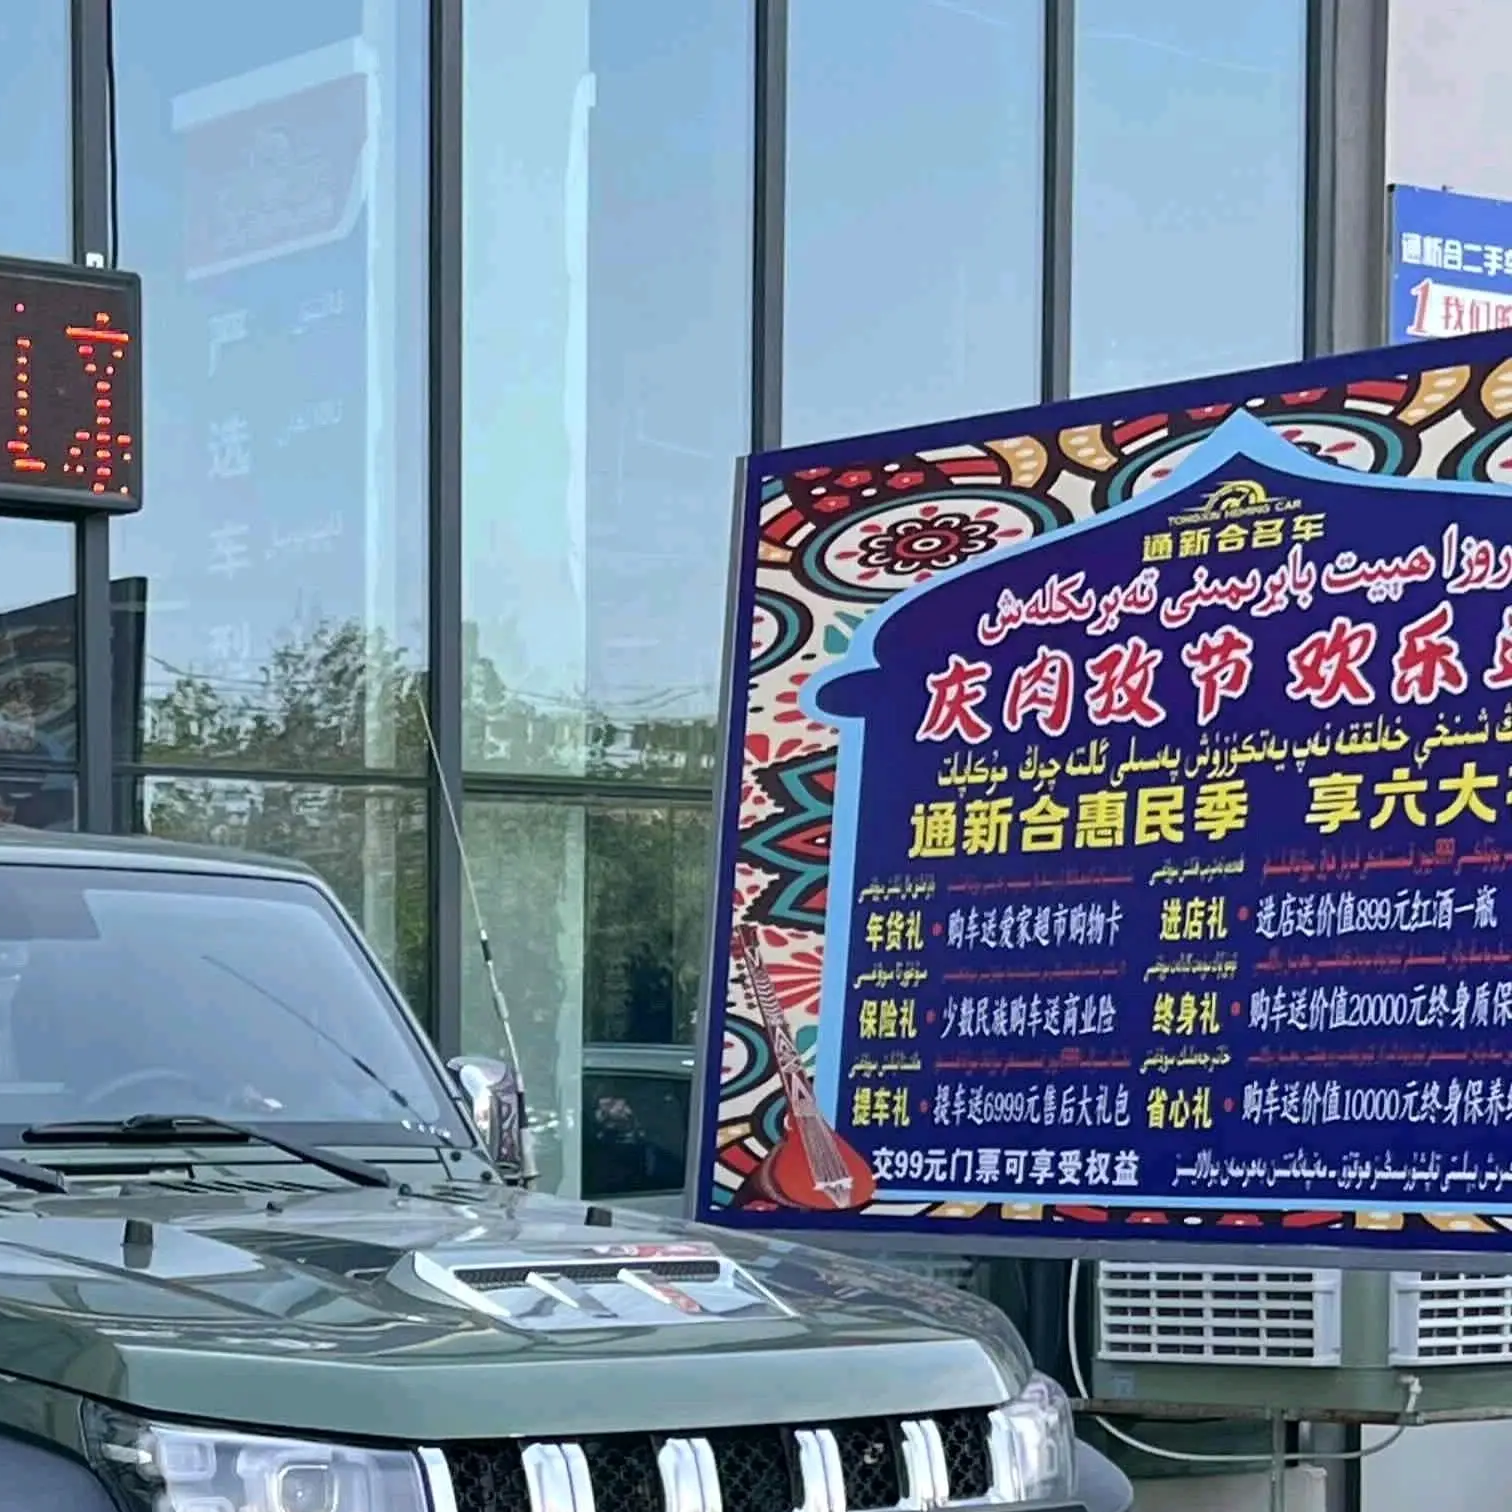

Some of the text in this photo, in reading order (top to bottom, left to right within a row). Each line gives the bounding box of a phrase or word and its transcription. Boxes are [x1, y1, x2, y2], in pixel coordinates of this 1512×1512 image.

[1274, 499, 1302, 512] CAR
[1142, 513, 1326, 562] 通新合名车
[907, 762, 1512, 859] 通新合惠民季 享六大
[865, 910, 924, 952] 年货礼
[1159, 884, 1498, 941] 进店礼 进店送价值899元红酒一瓶
[859, 992, 1118, 1040] 保险礼 少数民族购车送商业险
[1152, 991, 1220, 1035] 终身礼
[852, 1082, 1131, 1128] 提车礼 提车送6999元售后大礼包
[1146, 1076, 1512, 1129] 省心礼 购车送价值10000元终身保养
[872, 1147, 1140, 1187] 交99元门票可享受权益
